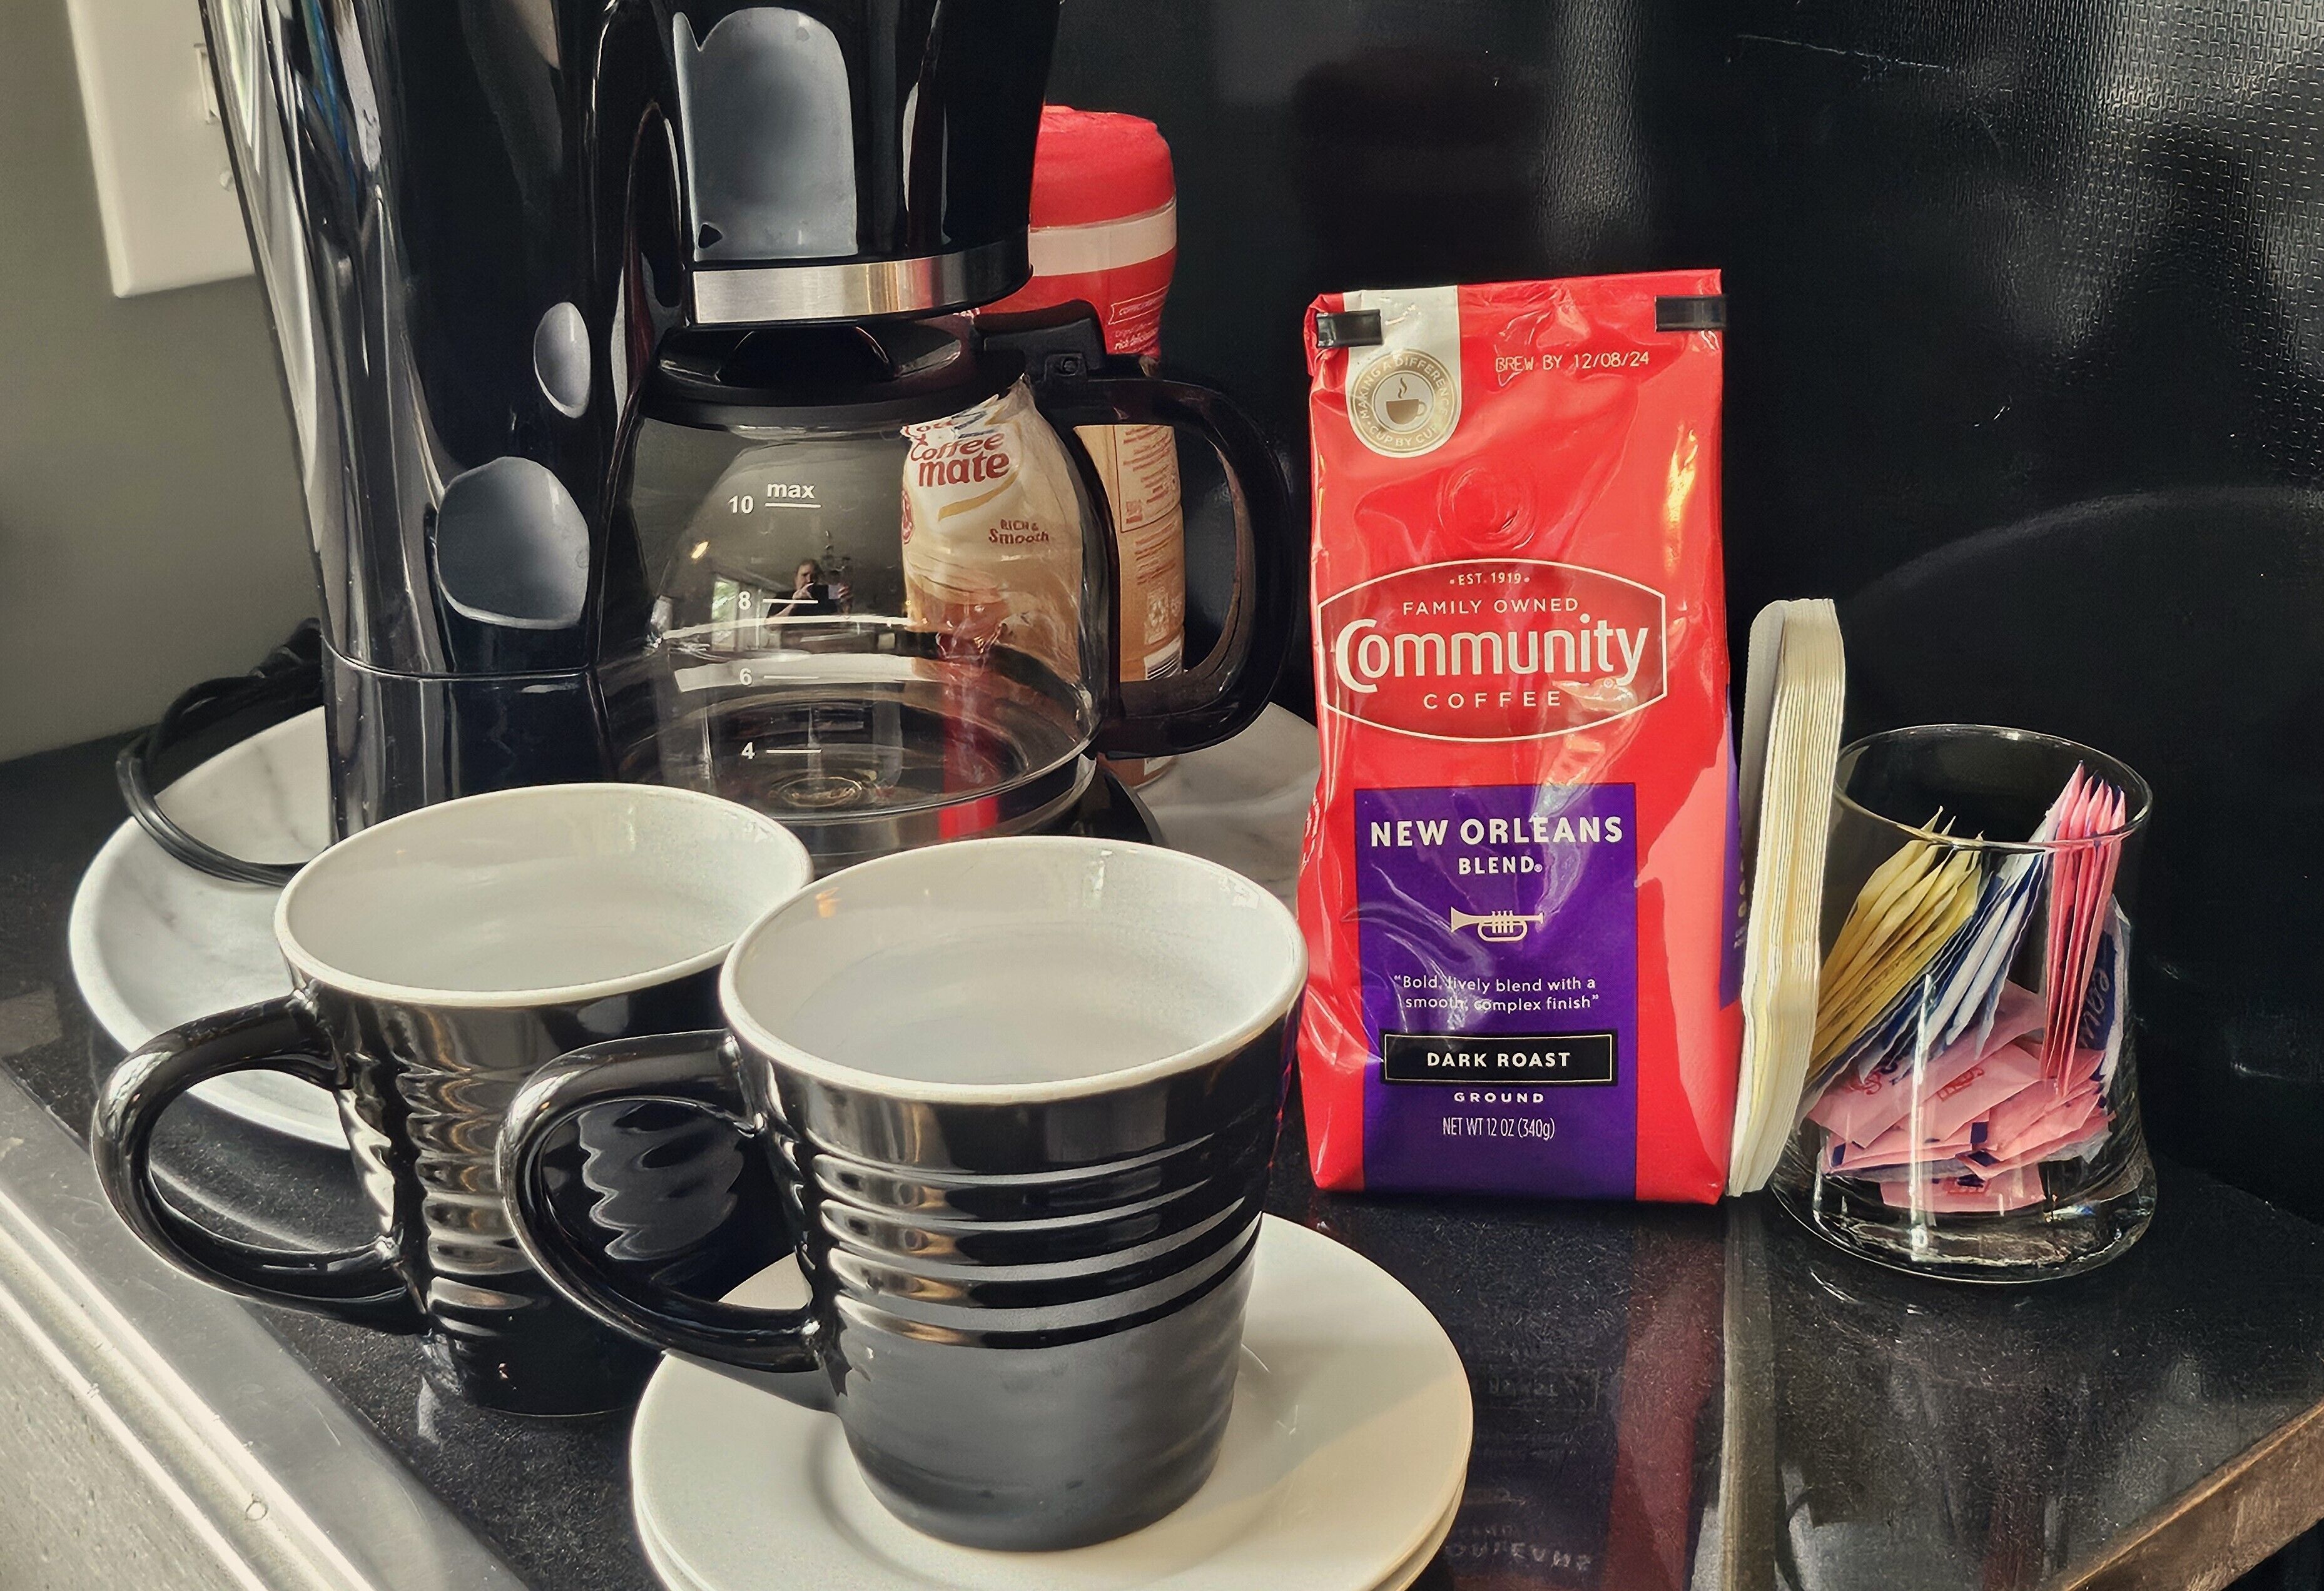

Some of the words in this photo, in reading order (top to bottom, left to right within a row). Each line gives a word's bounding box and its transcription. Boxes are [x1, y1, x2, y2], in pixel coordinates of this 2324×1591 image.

[1495, 356, 1534, 373] BREW
[1542, 355, 1563, 371] BY
[1573, 351, 1650, 369] 12/08/24
[1358, 370, 1381, 420] MAKING
[1383, 361, 1392, 371] A
[1370, 425, 1393, 444] CUP
[1395, 437, 1413, 447] BY
[918, 451, 1010, 487] mate
[767, 482, 815, 499] max
[729, 495, 754, 514] 10
[989, 528, 1049, 544] Smooth
[1491, 572, 1521, 585] 1919
[738, 590, 752, 610] 8
[1403, 599, 1482, 615] FAMILY
[1494, 597, 1578, 614] OWNED
[1335, 614, 1649, 693] Community
[739, 668, 752, 685] 6
[1423, 690, 1562, 710] COFFEE
[741, 741, 755, 759] 4
[1371, 819, 1449, 847] NEW
[1459, 816, 1623, 846] ORLEANS
[1448, 976, 1491, 994] lively
[1496, 979, 1542, 992] blend
[1547, 976, 1581, 991] with
[1586, 978, 1596, 989] a
[1473, 996, 1541, 1014] complex
[1427, 1052, 1488, 1068] DARK
[1497, 1052, 1571, 1068] ROAST
[1453, 1091, 1544, 1103] GROUND
[1442, 1116, 1463, 1136] NET
[1466, 1118, 1484, 1136] WT
[1486, 1118, 1498, 1137] 12
[1500, 1118, 1515, 1137] OZ
[1518, 1117, 1556, 1141] (340g)
